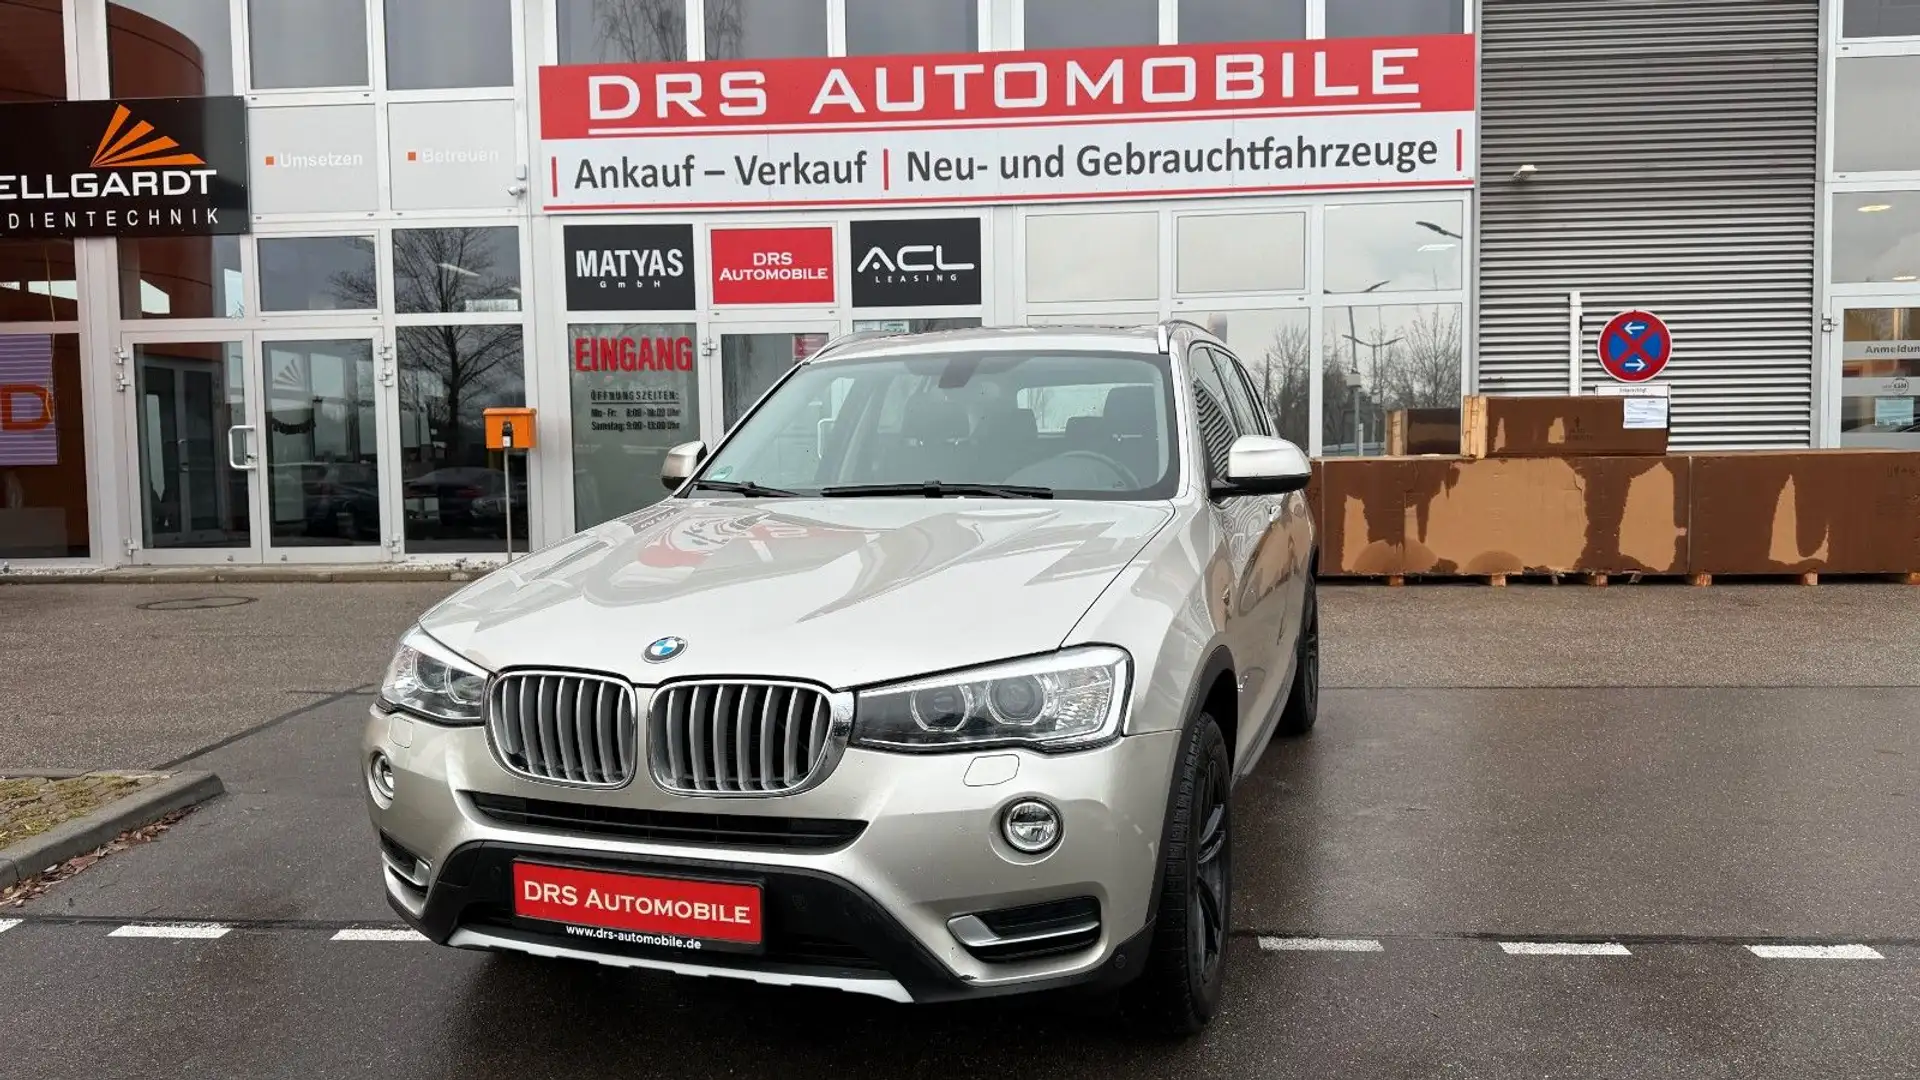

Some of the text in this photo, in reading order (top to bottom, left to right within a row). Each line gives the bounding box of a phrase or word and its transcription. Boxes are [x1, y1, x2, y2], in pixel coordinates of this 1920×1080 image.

[588, 47, 1419, 120] DRS AUTOMOBILE
[279, 151, 363, 168] Umsetzen
[422, 147, 499, 164] Betreuen
[574, 155, 695, 189] Ankauf
[734, 151, 867, 186] Verkauf
[906, 151, 988, 182] Neu-
[999, 144, 1065, 178] und
[1076, 136, 1438, 178] Gebrauchtfahrzeuge
[8, 208, 219, 229] DIENTECHNIK
[575, 248, 685, 278] MATYAS
[753, 251, 793, 266] DRS
[857, 244, 976, 273] ACL
[719, 266, 829, 282] AUTOMOBILE
[875, 273, 957, 284] LEASING
[575, 336, 693, 372] EINGANG
[523, 880, 751, 924] DRS AUTOMOBILE
[565, 925, 702, 950] www.drs-automobile.de
